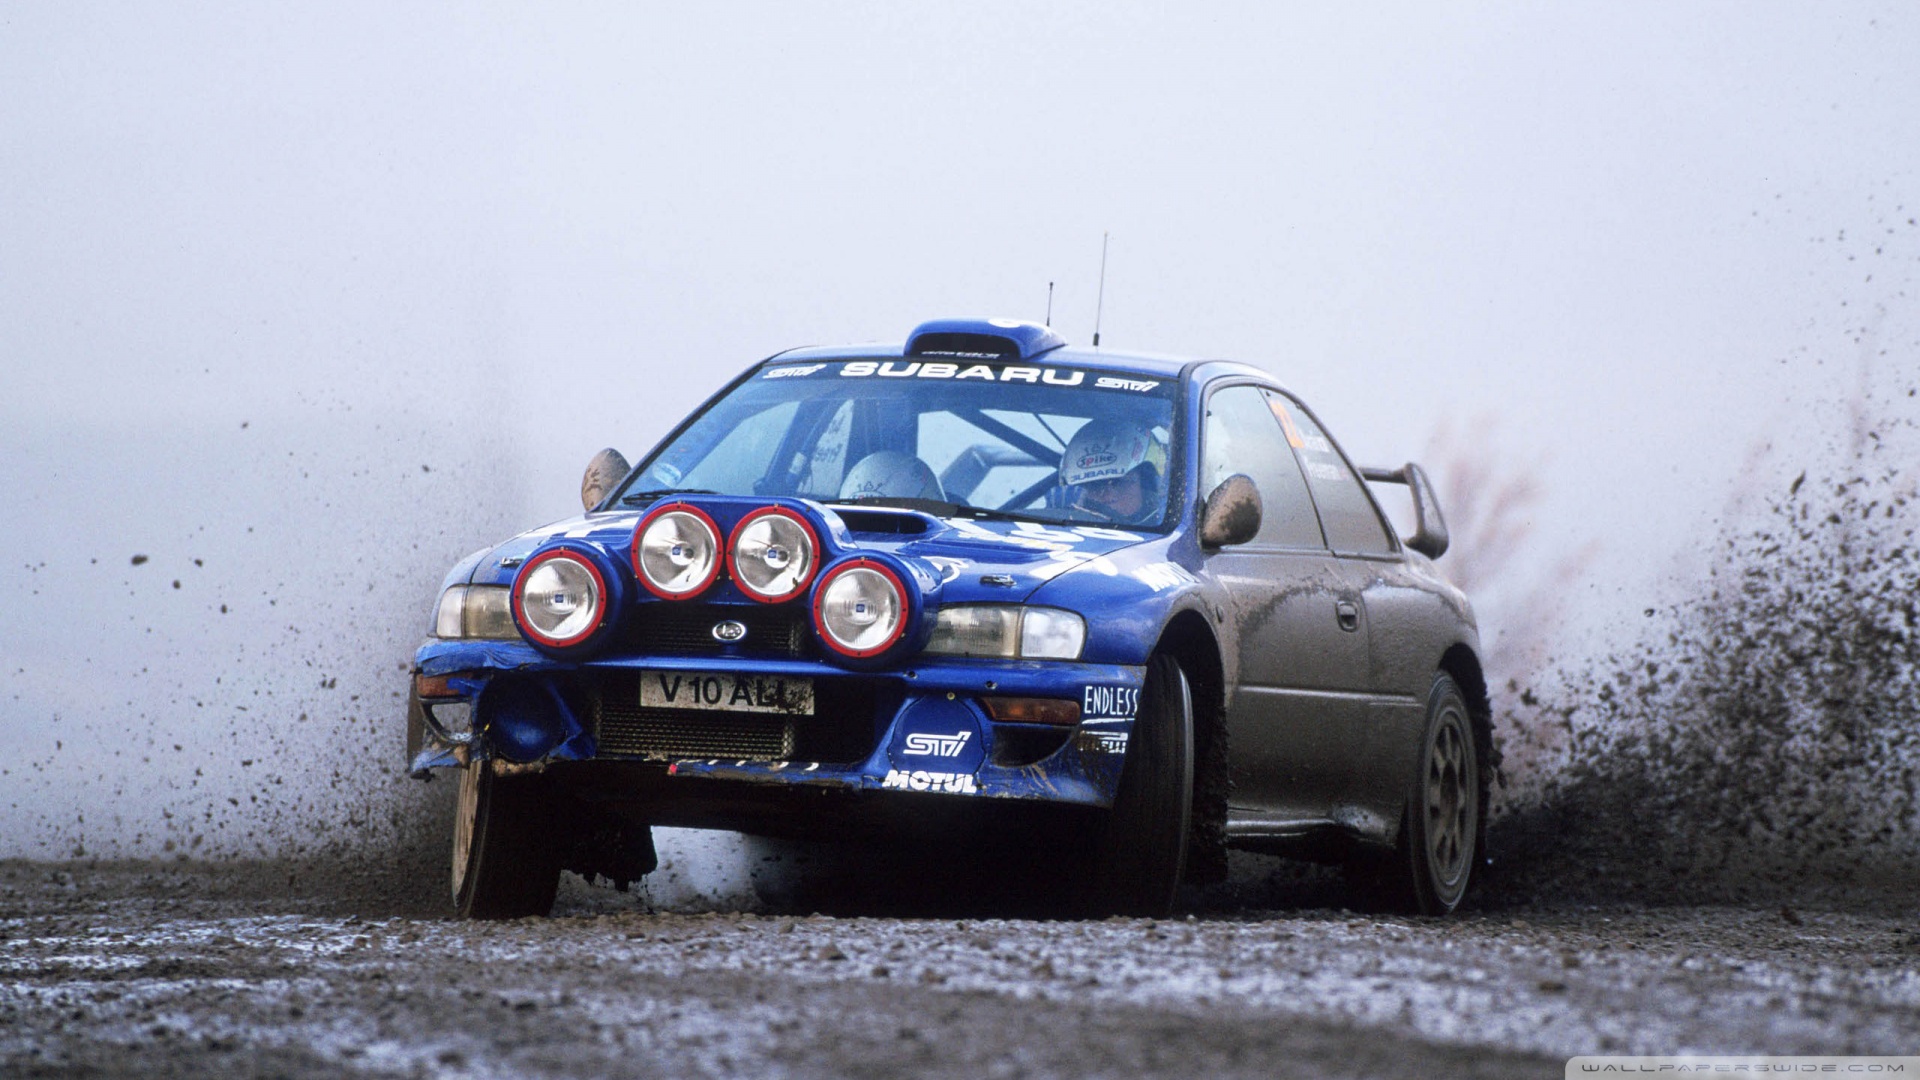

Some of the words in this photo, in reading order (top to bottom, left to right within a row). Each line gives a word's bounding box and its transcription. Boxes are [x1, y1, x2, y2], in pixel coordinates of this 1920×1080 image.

[839, 361, 1085, 387] SUBARU
[1084, 685, 1138, 716] ENDLESS
[882, 770, 977, 794] MOTUL
